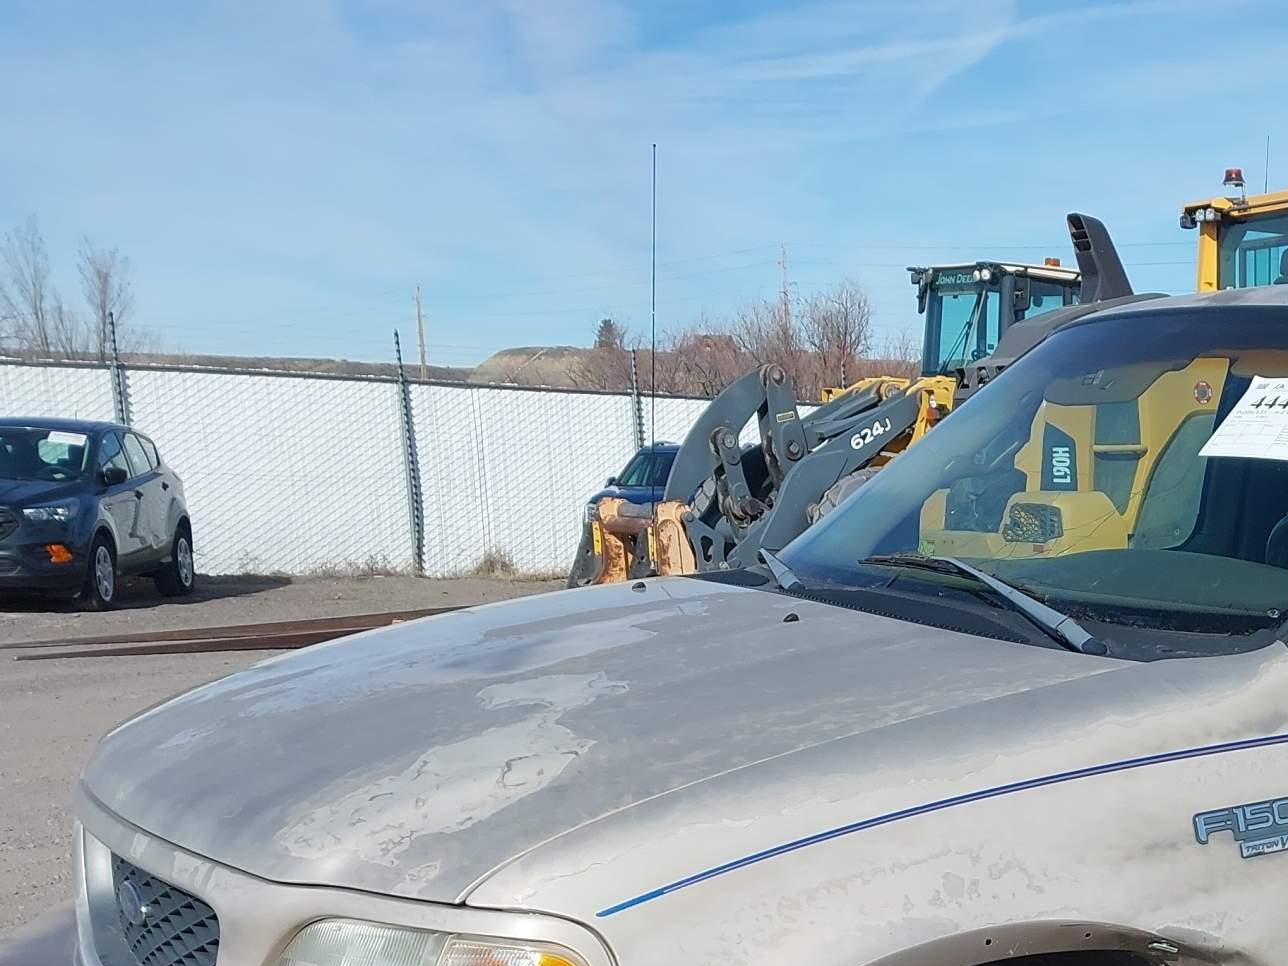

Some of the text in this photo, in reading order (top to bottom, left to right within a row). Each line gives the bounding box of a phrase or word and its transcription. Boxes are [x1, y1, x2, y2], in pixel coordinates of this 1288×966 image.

[935, 272, 956, 285] JOHN
[850, 418, 891, 450] 624J
[1052, 447, 1071, 483] L90H
[1246, 840, 1279, 853] TRITON
